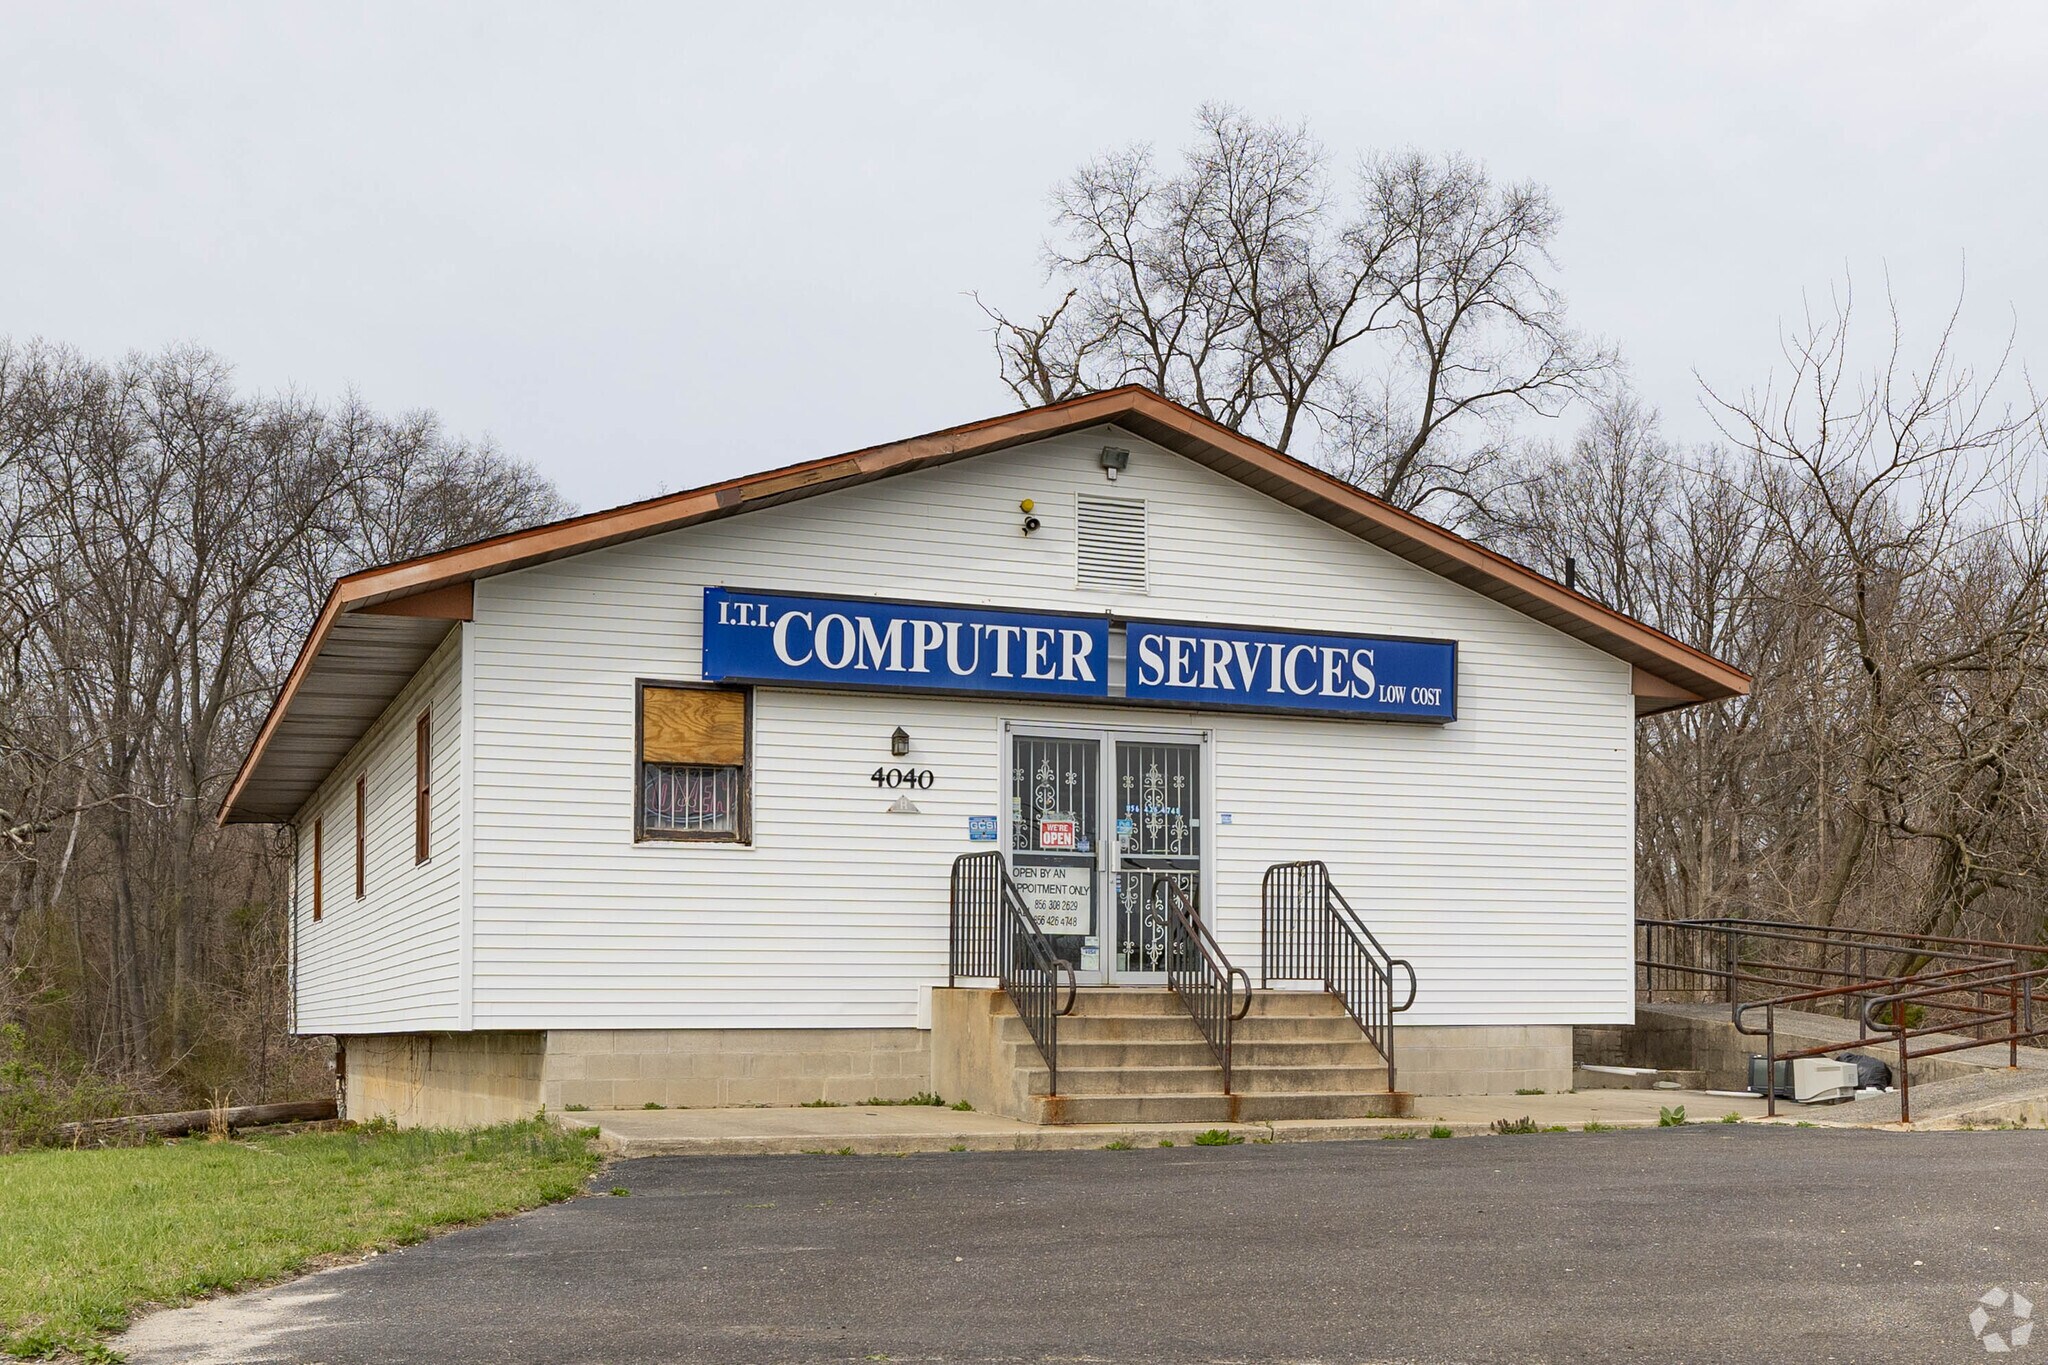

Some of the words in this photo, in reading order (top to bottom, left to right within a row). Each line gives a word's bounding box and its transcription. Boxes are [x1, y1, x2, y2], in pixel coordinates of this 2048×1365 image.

[772, 610, 1096, 682] COMPUTER
[1138, 633, 1376, 699] SERVICES
[1379, 685, 1406, 704] LOW
[1411, 687, 1442, 706] COST
[870, 766, 934, 790] 4040
[1046, 823, 1069, 832] WE'RE
[1043, 831, 1072, 845] OPEN
[1012, 867, 1038, 878] OPEN
[1040, 868, 1051, 878] BY
[1053, 868, 1066, 879] AN
[1014, 883, 1068, 894] PPOITMENT
[1068, 885, 1090, 896] ONLY
[1034, 899, 1047, 910] 856
[1048, 900, 1060, 910] 308
[1061, 900, 1078, 911] 2629
[1046, 916, 1059, 926] 426
[1060, 916, 1077, 927] 4748
